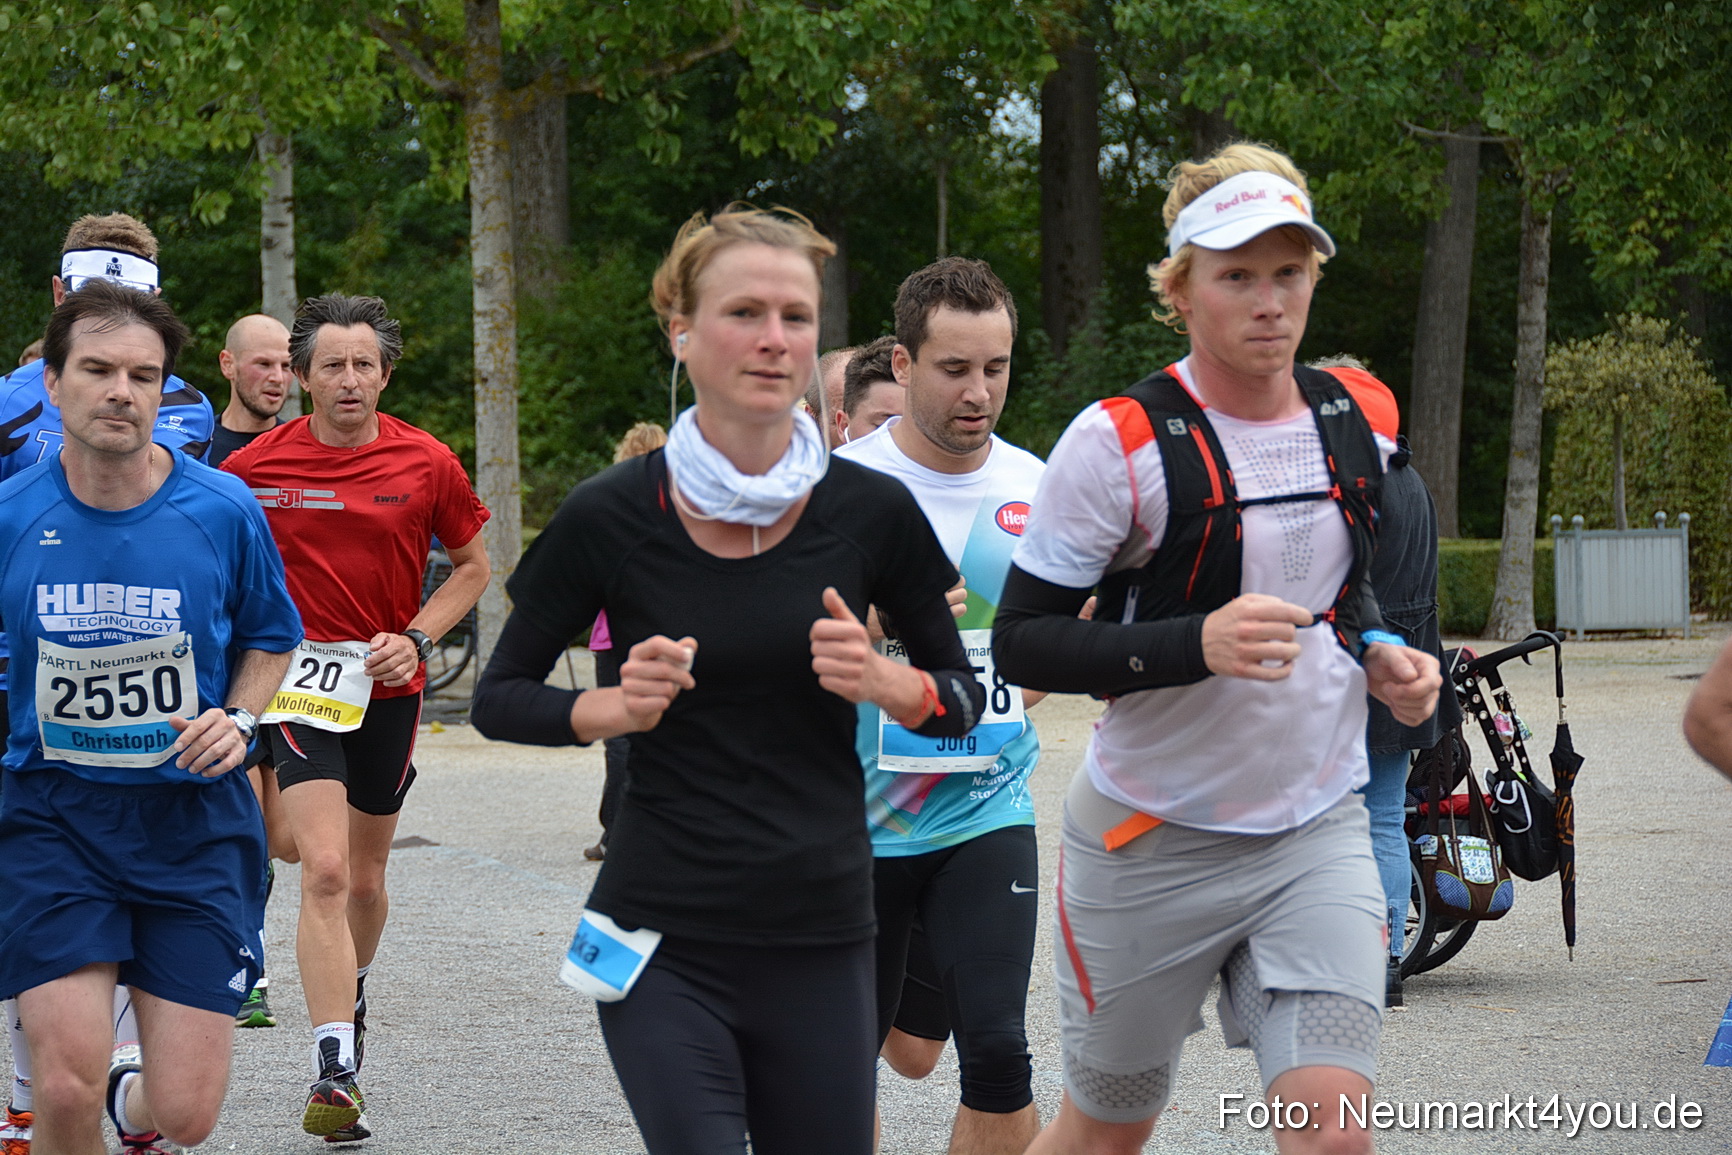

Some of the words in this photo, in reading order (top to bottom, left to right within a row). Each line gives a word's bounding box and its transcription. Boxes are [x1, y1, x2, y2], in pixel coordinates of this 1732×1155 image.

[1214, 194, 1240, 213] Red
[1240, 188, 1267, 203] Bull
[1002, 510, 1028, 525] Her
[36, 583, 181, 619] HUBER
[66, 615, 174, 632] TECHNOLOGY
[67, 633, 100, 643] WASTE
[102, 631, 133, 643] WATER
[40, 651, 86, 671] PARTL
[90, 650, 166, 670] Neumarkt
[309, 644, 360, 660] Neumarkt
[293, 657, 343, 693] 20
[50, 665, 183, 721] 2550
[276, 695, 342, 723] Wolfgang
[71, 729, 168, 752] Christoph
